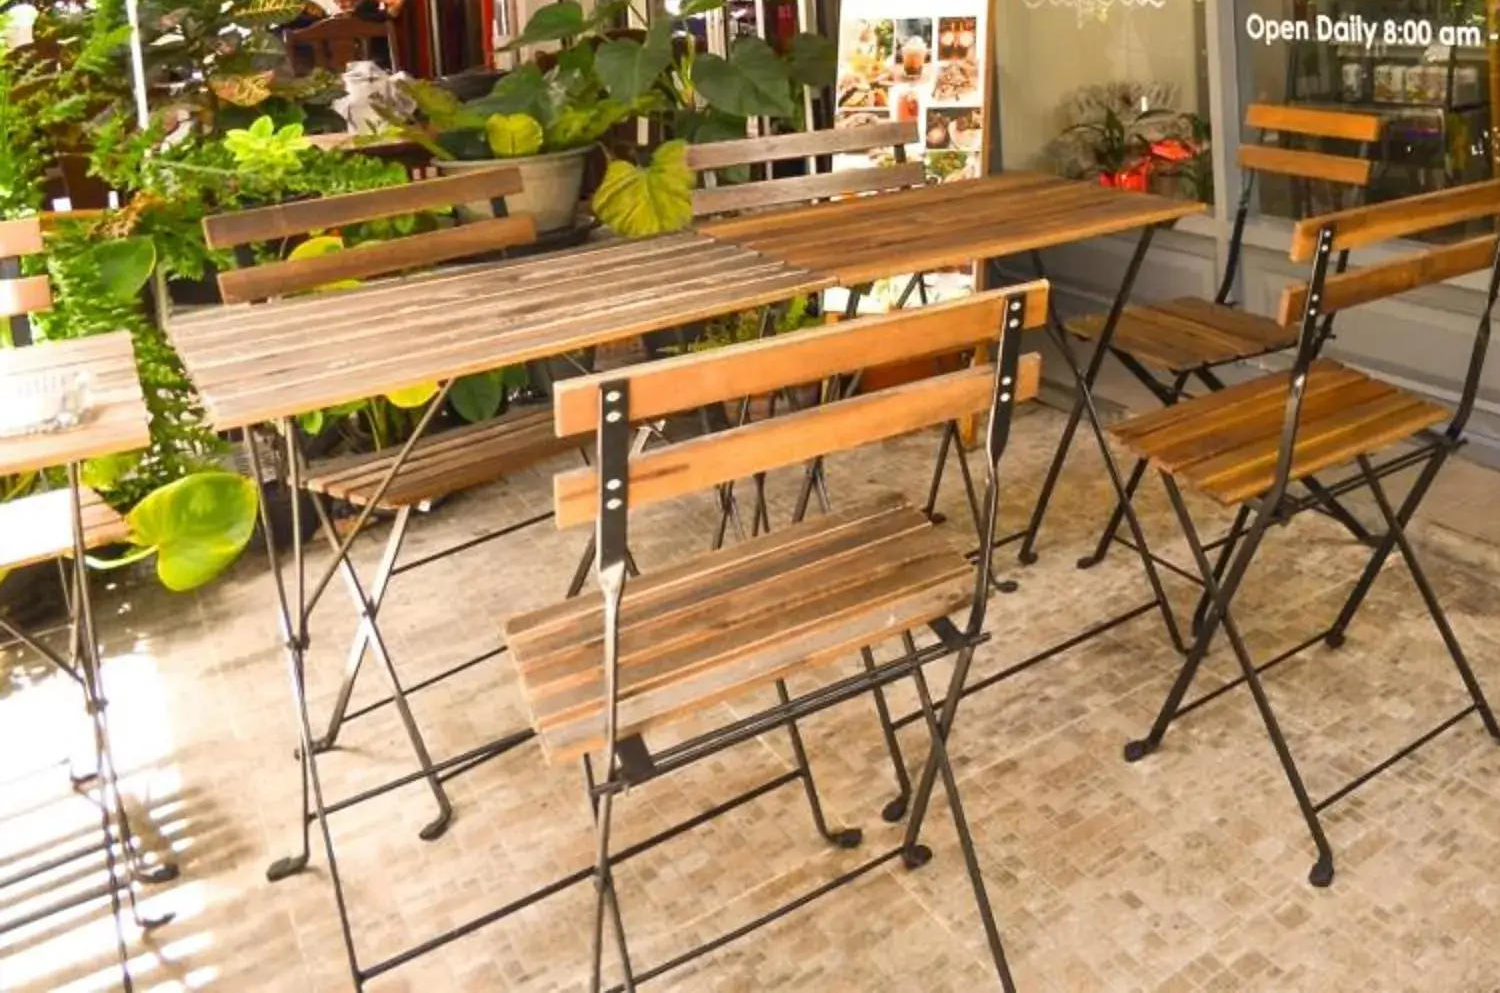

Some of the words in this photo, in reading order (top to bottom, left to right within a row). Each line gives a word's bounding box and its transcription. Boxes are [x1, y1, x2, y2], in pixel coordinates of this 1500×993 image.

[1245, 13, 1310, 46] Open
[1316, 14, 1379, 50] Daily
[1383, 19, 1431, 47] 8:00
[1438, 23, 1481, 47] am
